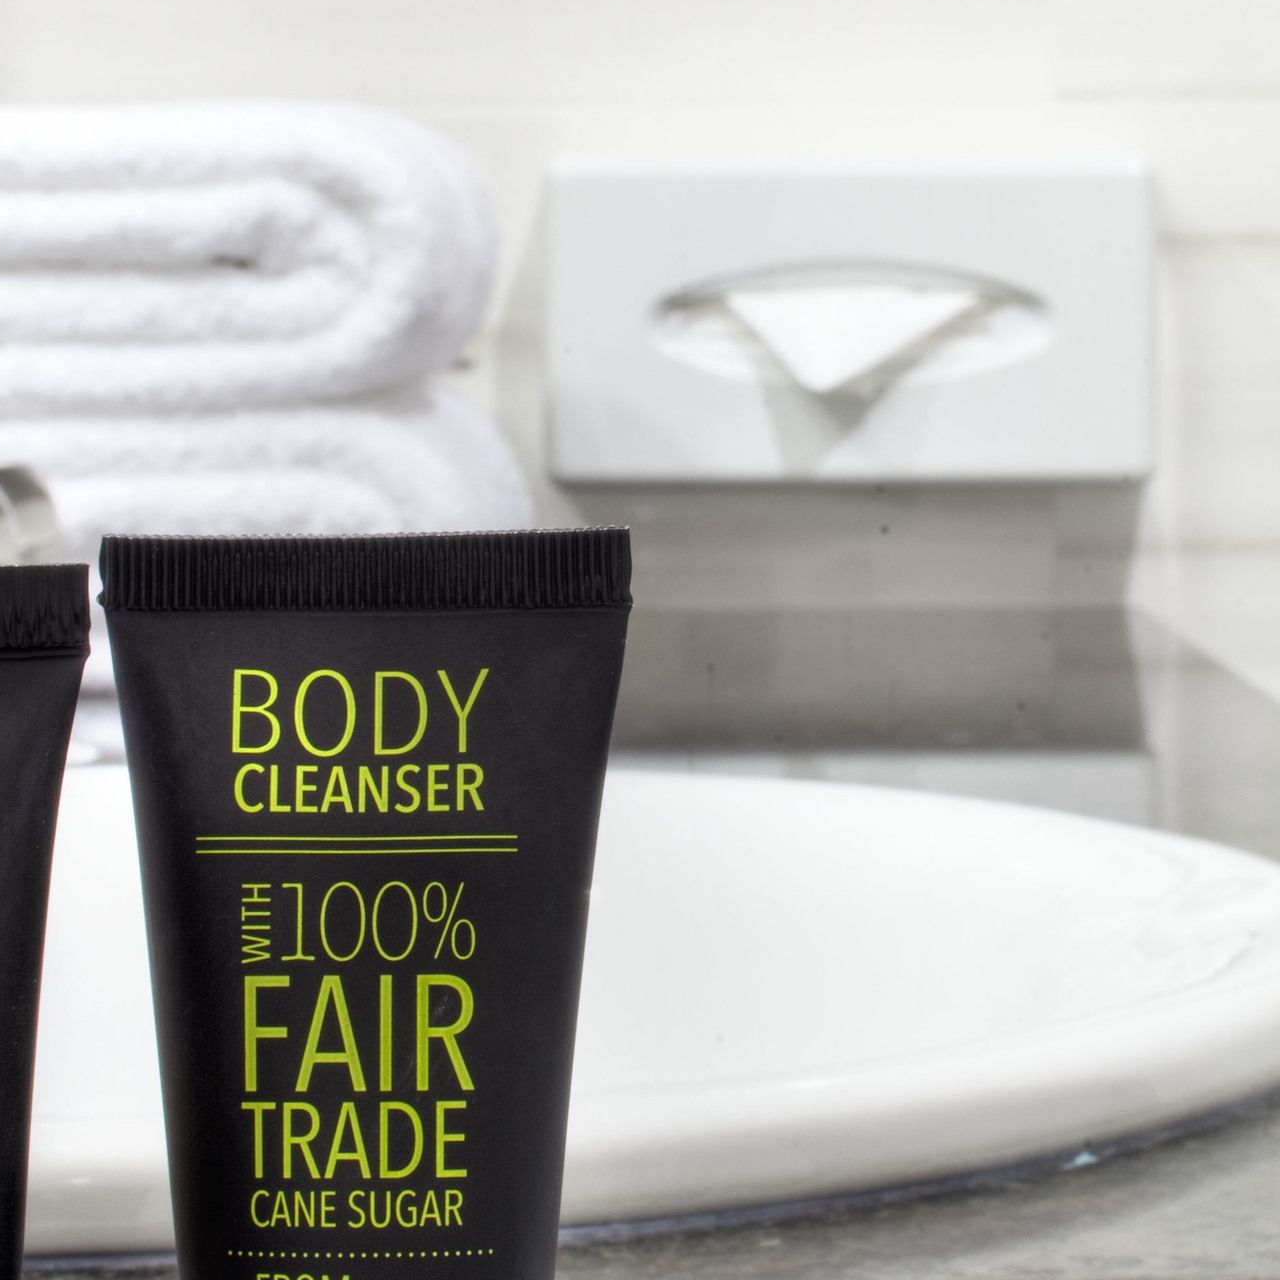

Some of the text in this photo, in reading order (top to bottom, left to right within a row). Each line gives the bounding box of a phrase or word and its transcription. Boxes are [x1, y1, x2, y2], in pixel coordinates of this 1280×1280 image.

[232, 669, 488, 757] BODY
[234, 763, 483, 813] CLEANSER
[242, 881, 475, 963] WITH 100%
[245, 974, 474, 1092] FAIR
[242, 1101, 467, 1179] TRADE
[251, 1190, 463, 1228] CANE SUGAR
